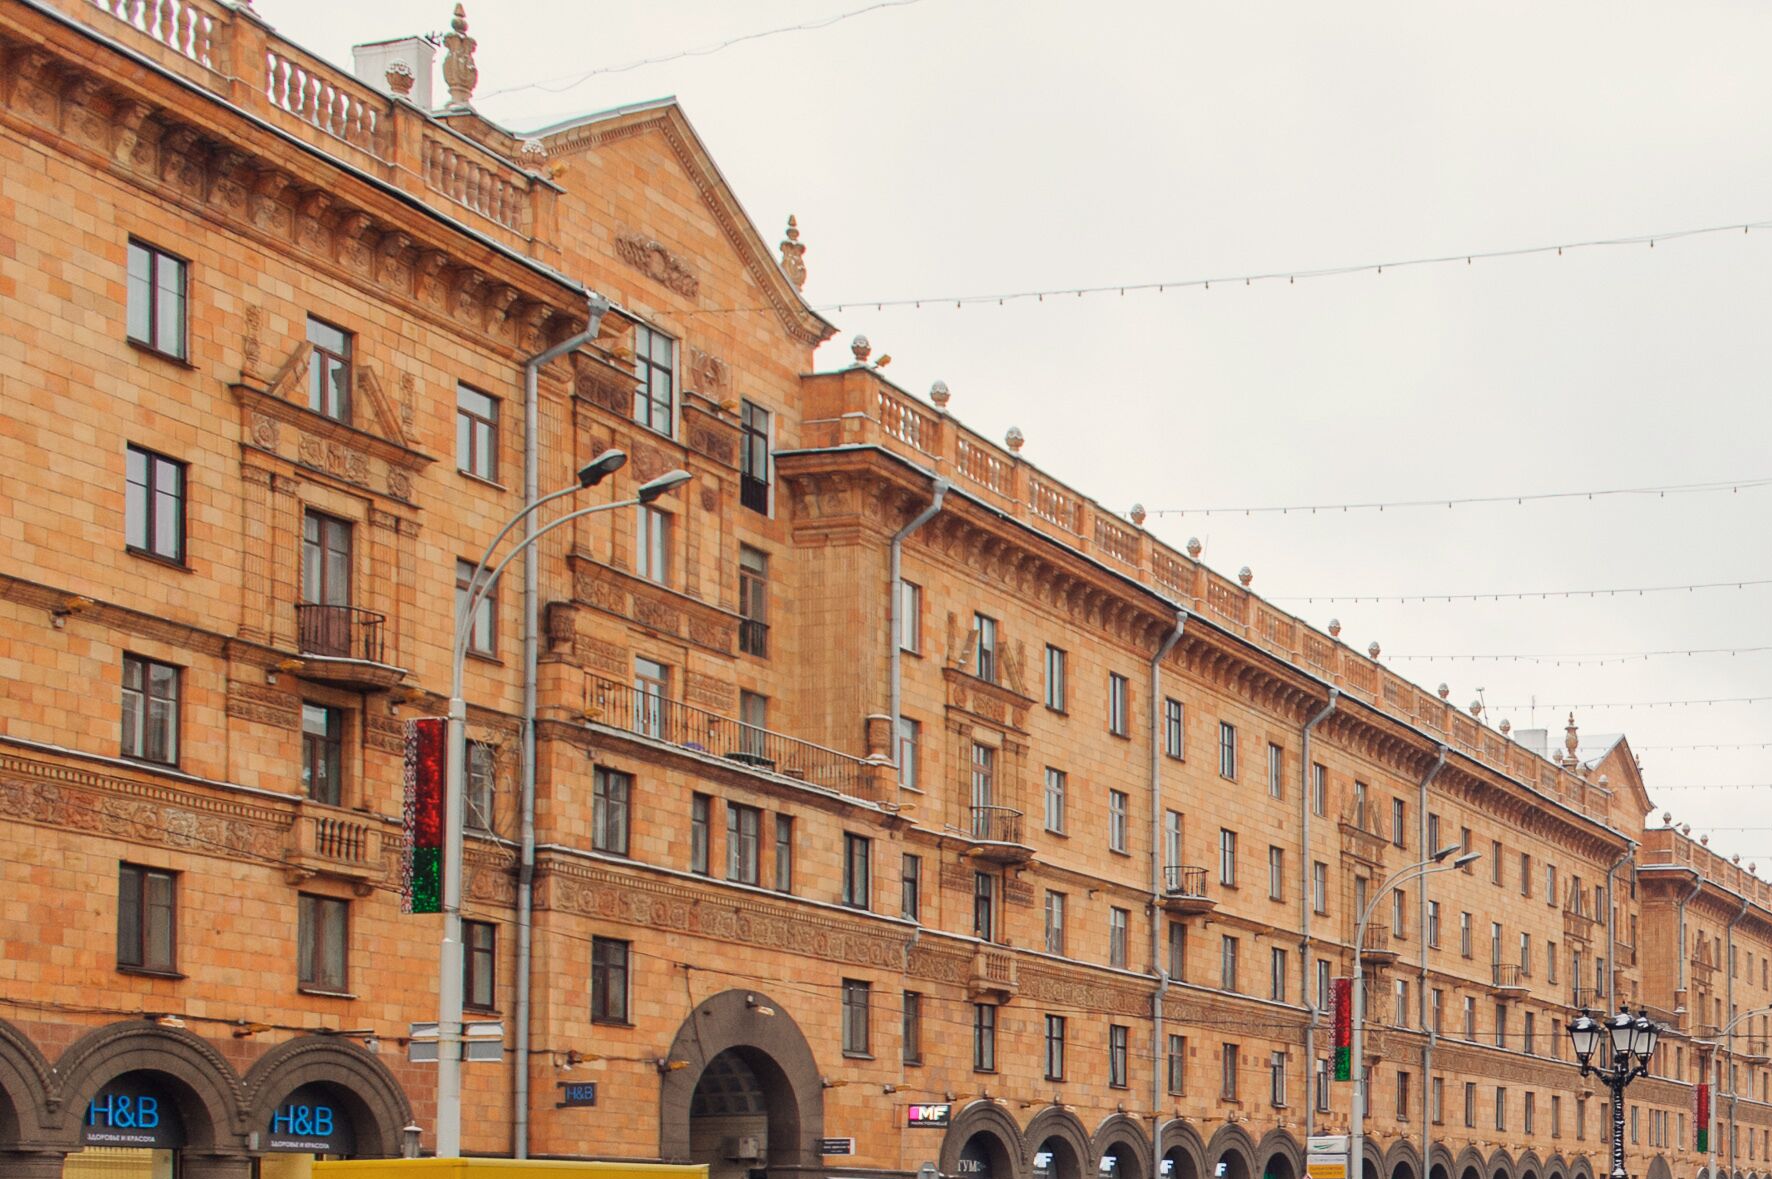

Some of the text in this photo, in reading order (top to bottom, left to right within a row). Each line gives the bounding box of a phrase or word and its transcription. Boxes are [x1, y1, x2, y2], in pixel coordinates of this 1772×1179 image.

[566, 1086, 593, 1101] H&B
[89, 1095, 159, 1128] H&B
[274, 1105, 334, 1136] H&B
[958, 1160, 977, 1172] ГУМ
